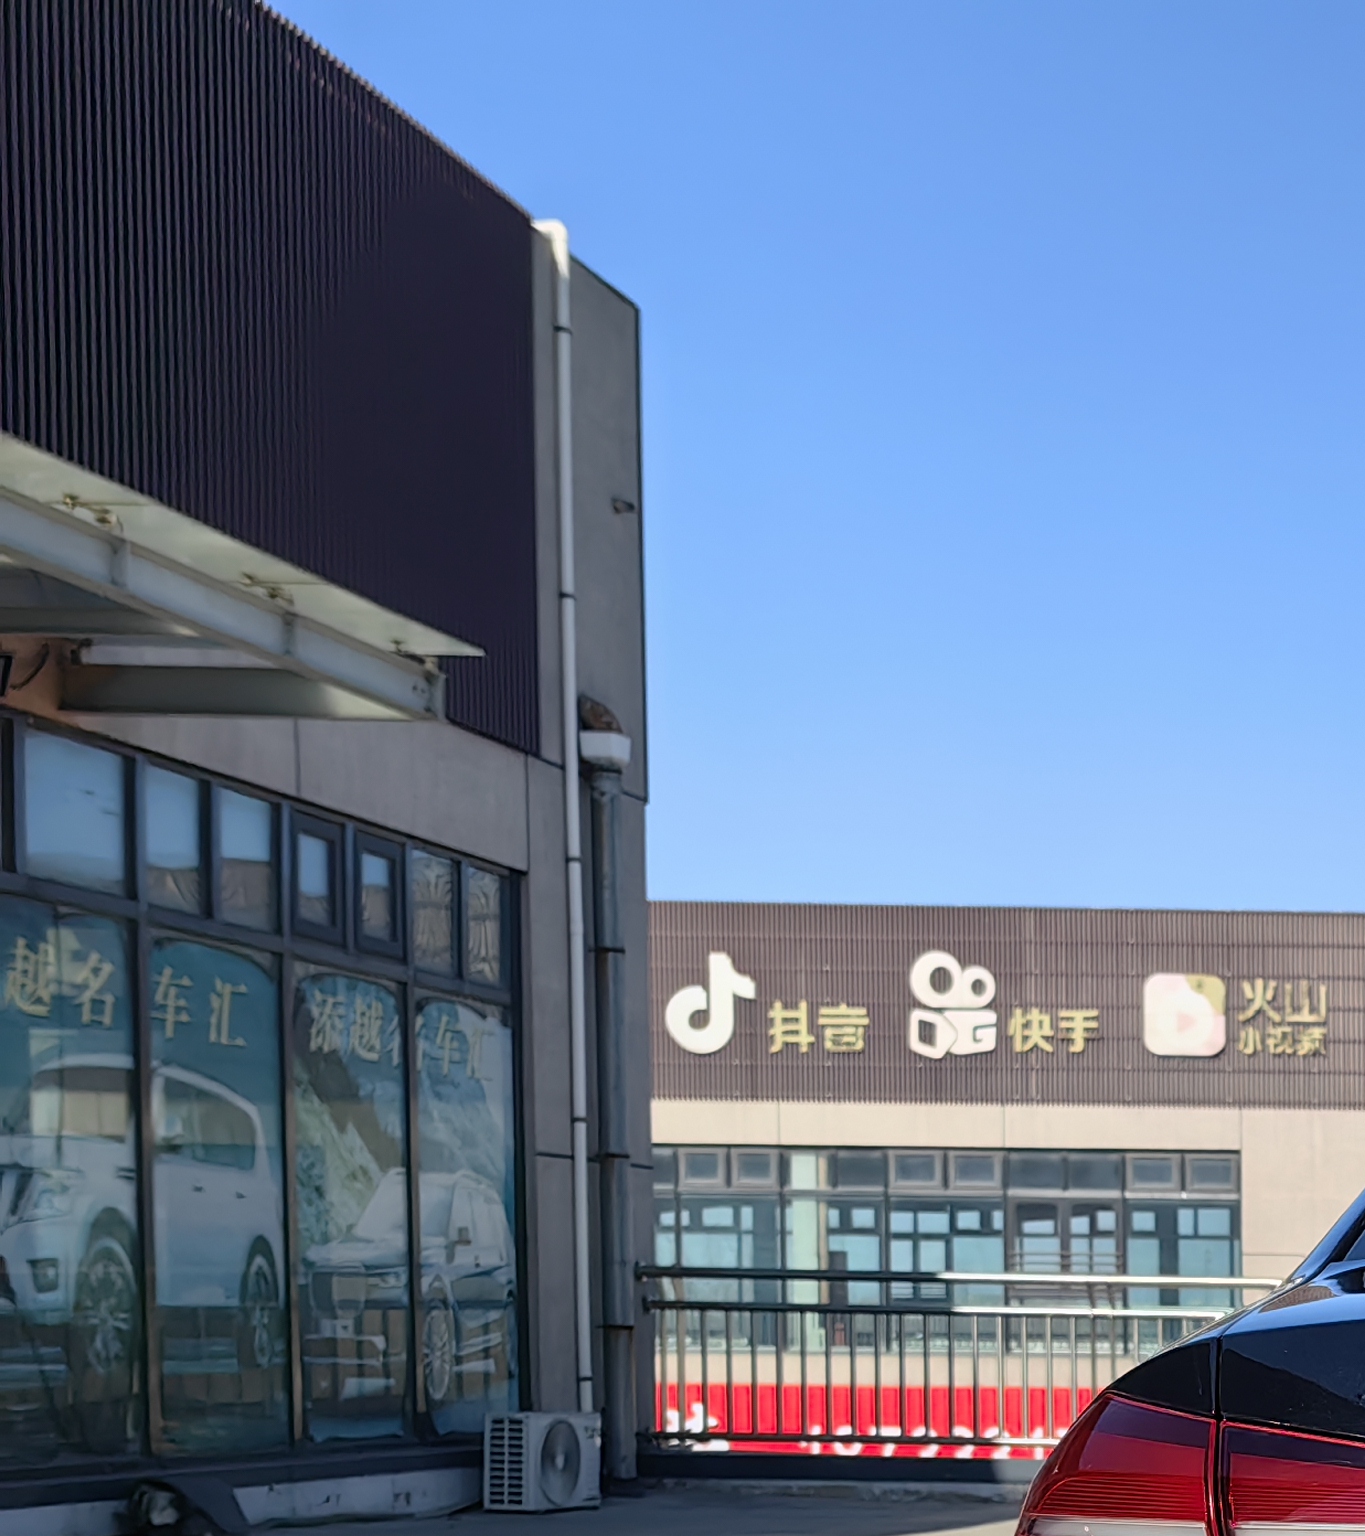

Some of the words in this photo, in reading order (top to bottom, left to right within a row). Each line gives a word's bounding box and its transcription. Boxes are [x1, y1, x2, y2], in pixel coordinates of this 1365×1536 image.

[1238, 977, 1327, 1023] 火山
[768, 999, 870, 1054] 抖音
[1008, 1007, 1099, 1054] 快手
[1238, 1023, 1328, 1056] 小视频
